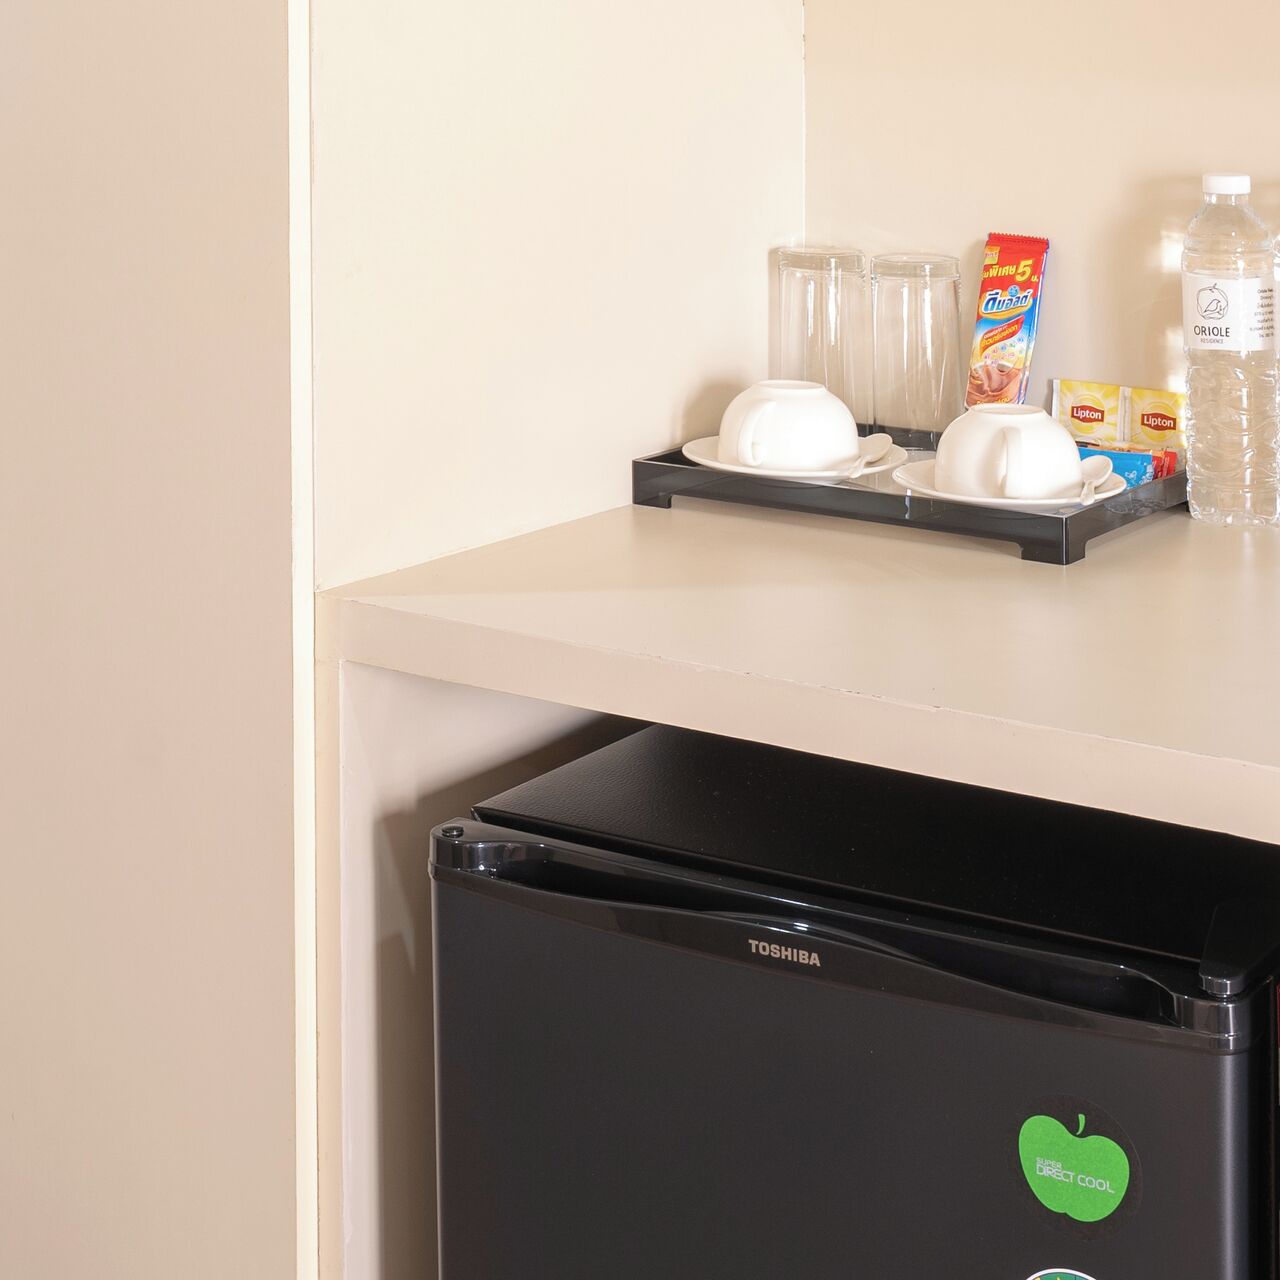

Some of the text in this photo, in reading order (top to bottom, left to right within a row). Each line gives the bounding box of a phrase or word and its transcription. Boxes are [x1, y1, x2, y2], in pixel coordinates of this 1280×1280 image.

[1015, 260, 1033, 282] 5
[1193, 325, 1230, 337] ORIOLE
[1073, 408, 1102, 420] Lipton
[1143, 415, 1174, 428] Lipton
[748, 939, 821, 967] TOSHIBA
[1036, 1157, 1062, 1169] SUPER
[1036, 1164, 1116, 1194] DIRECT COOL
